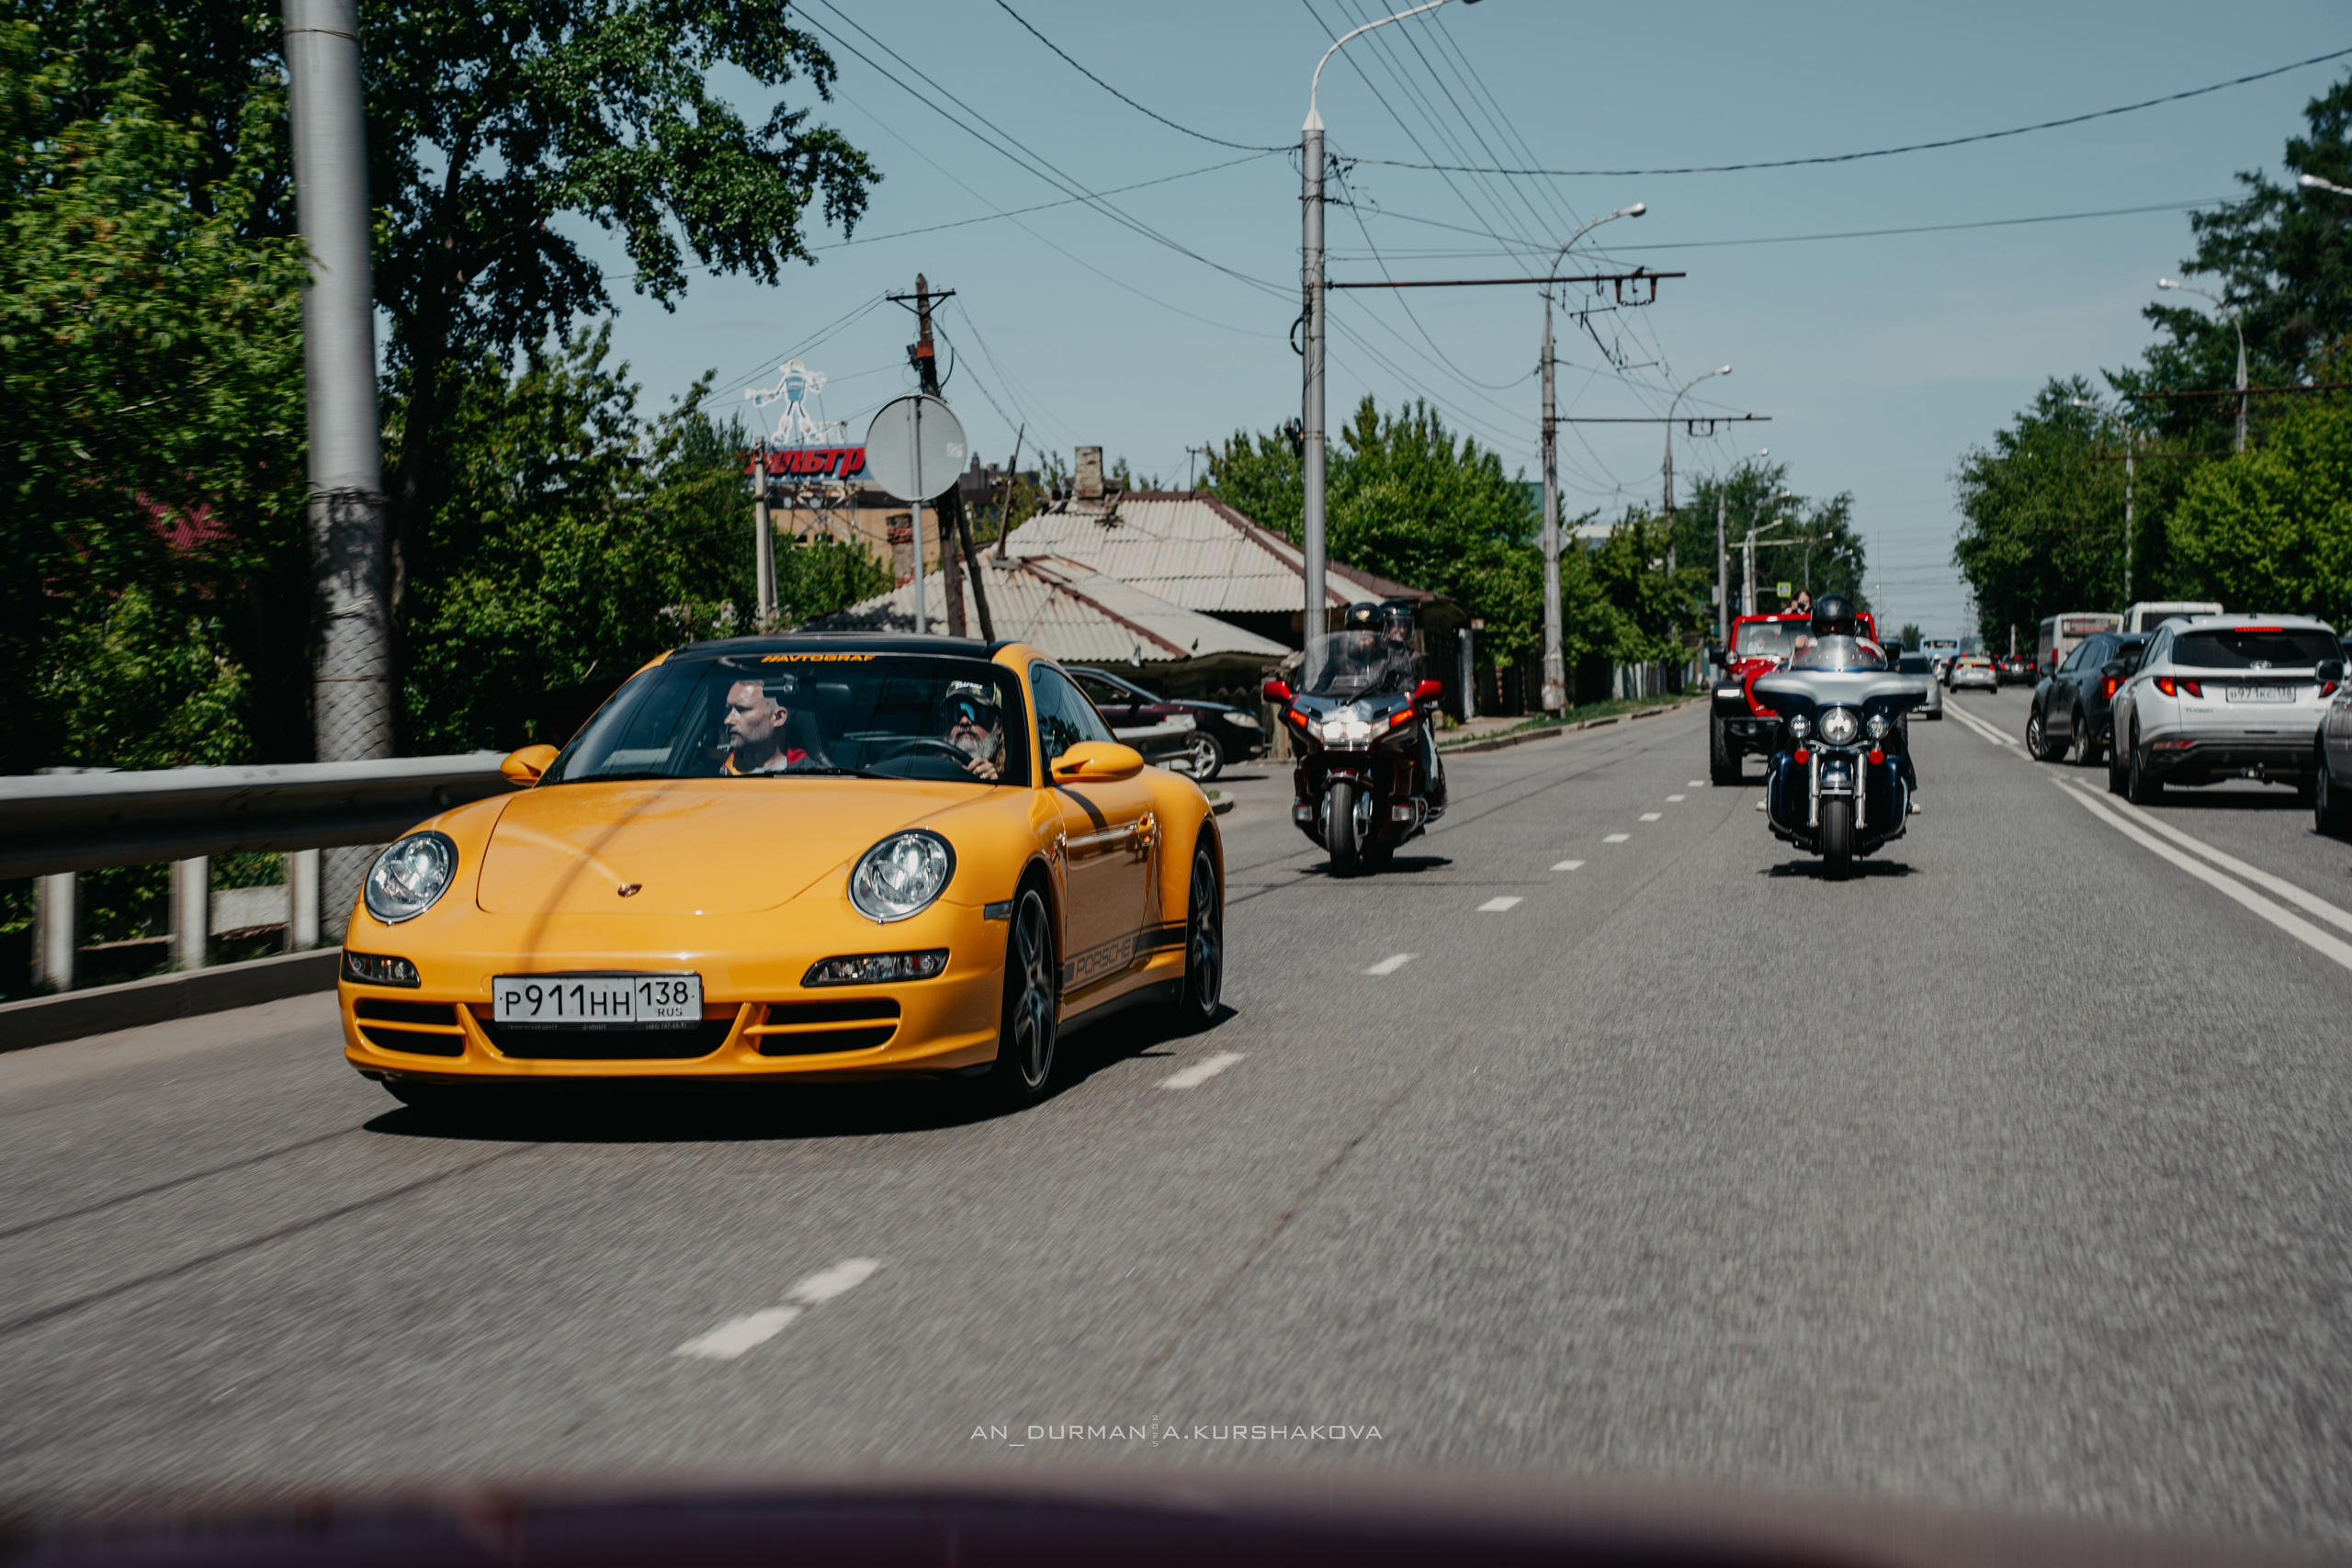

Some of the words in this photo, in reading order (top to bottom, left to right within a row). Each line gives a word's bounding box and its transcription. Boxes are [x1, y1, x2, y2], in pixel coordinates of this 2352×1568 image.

[1076, 938, 1132, 979] PORSCHE
[639, 981, 688, 1006] 138
[657, 1008, 683, 1017] RUS
